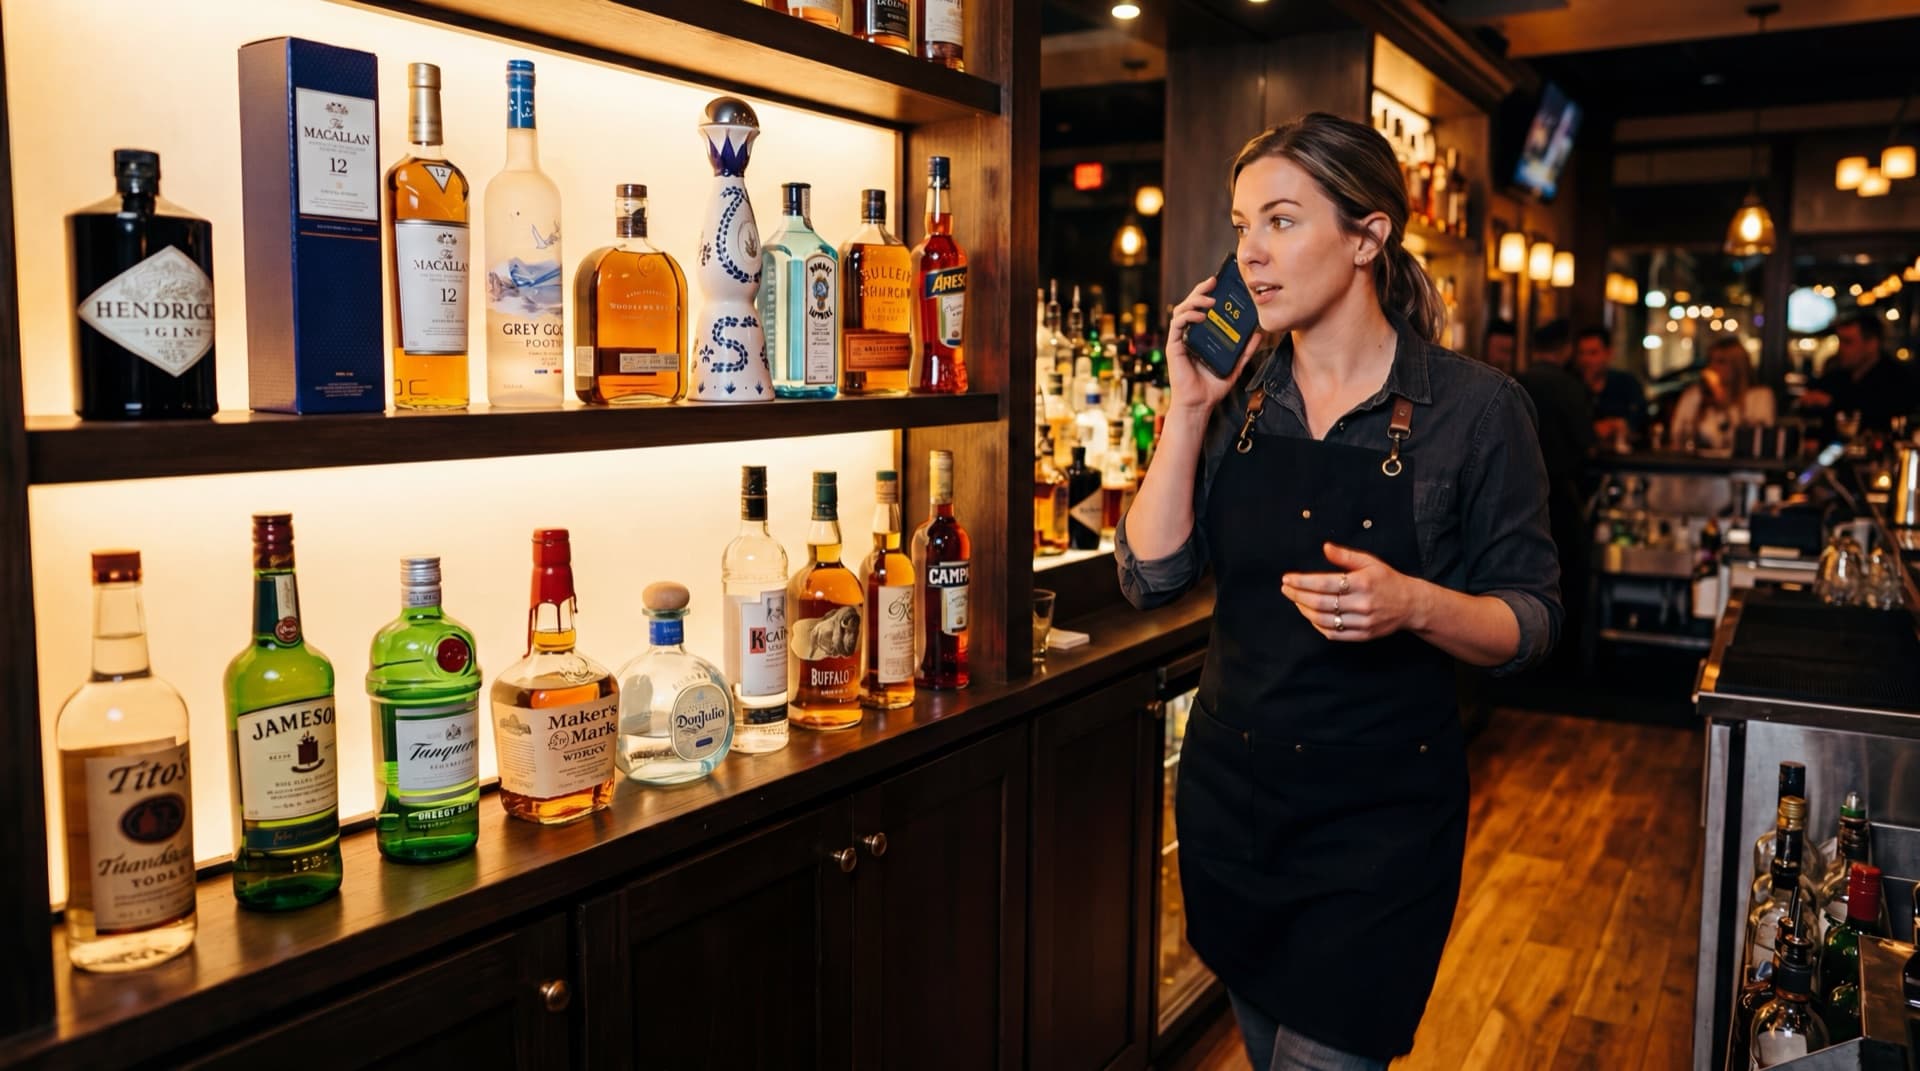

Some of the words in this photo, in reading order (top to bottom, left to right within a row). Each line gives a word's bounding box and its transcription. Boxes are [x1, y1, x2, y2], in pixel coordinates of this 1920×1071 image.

[304, 125, 371, 146] MACALLAN
[329, 157, 348, 174] 12
[435, 167, 447, 178] 12
[440, 287, 457, 303] 12
[1224, 301, 1241, 320] 0.6
[502, 323, 540, 336] GREY
[811, 667, 850, 687] BUFFALO
[548, 704, 617, 730] Maker's
[571, 721, 616, 745] Mark
